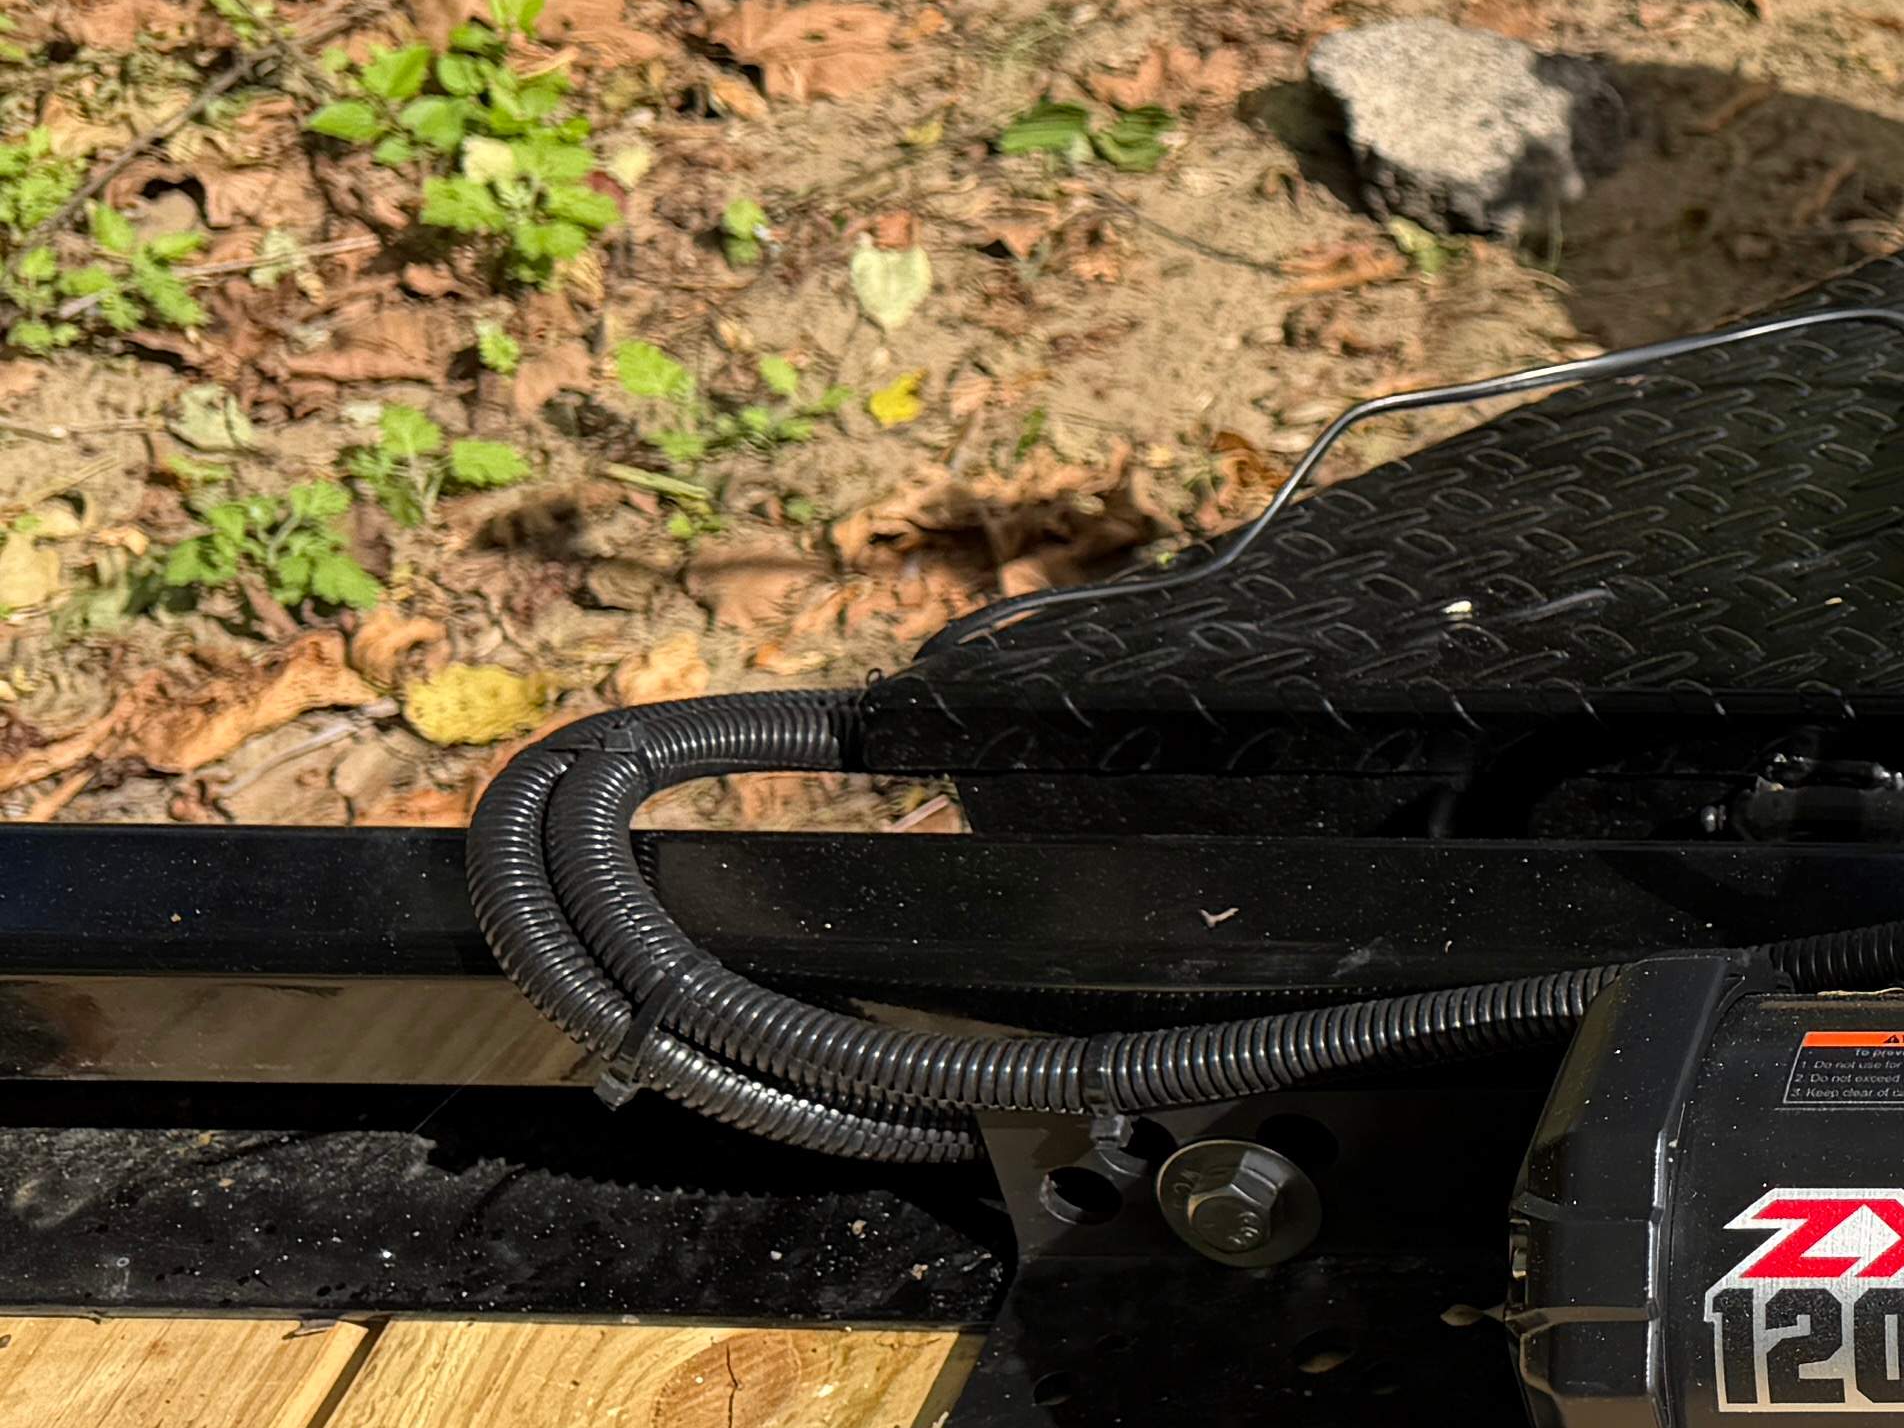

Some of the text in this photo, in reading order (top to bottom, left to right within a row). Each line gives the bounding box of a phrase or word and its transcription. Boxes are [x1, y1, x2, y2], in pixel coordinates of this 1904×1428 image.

[1854, 1049, 1870, 1059] To
[1812, 1061, 1832, 1071] Do
[1832, 1061, 1855, 1071] not
[1858, 1061, 1882, 1071] use
[1884, 1061, 1904, 1071] for
[1809, 1074, 1828, 1085] Do
[1830, 1074, 1853, 1085] not
[1854, 1074, 1900, 1085] exceed
[1805, 1088, 1839, 1099] Keep
[1841, 1088, 1874, 1099] clear
[1876, 1088, 1890, 1099] of
